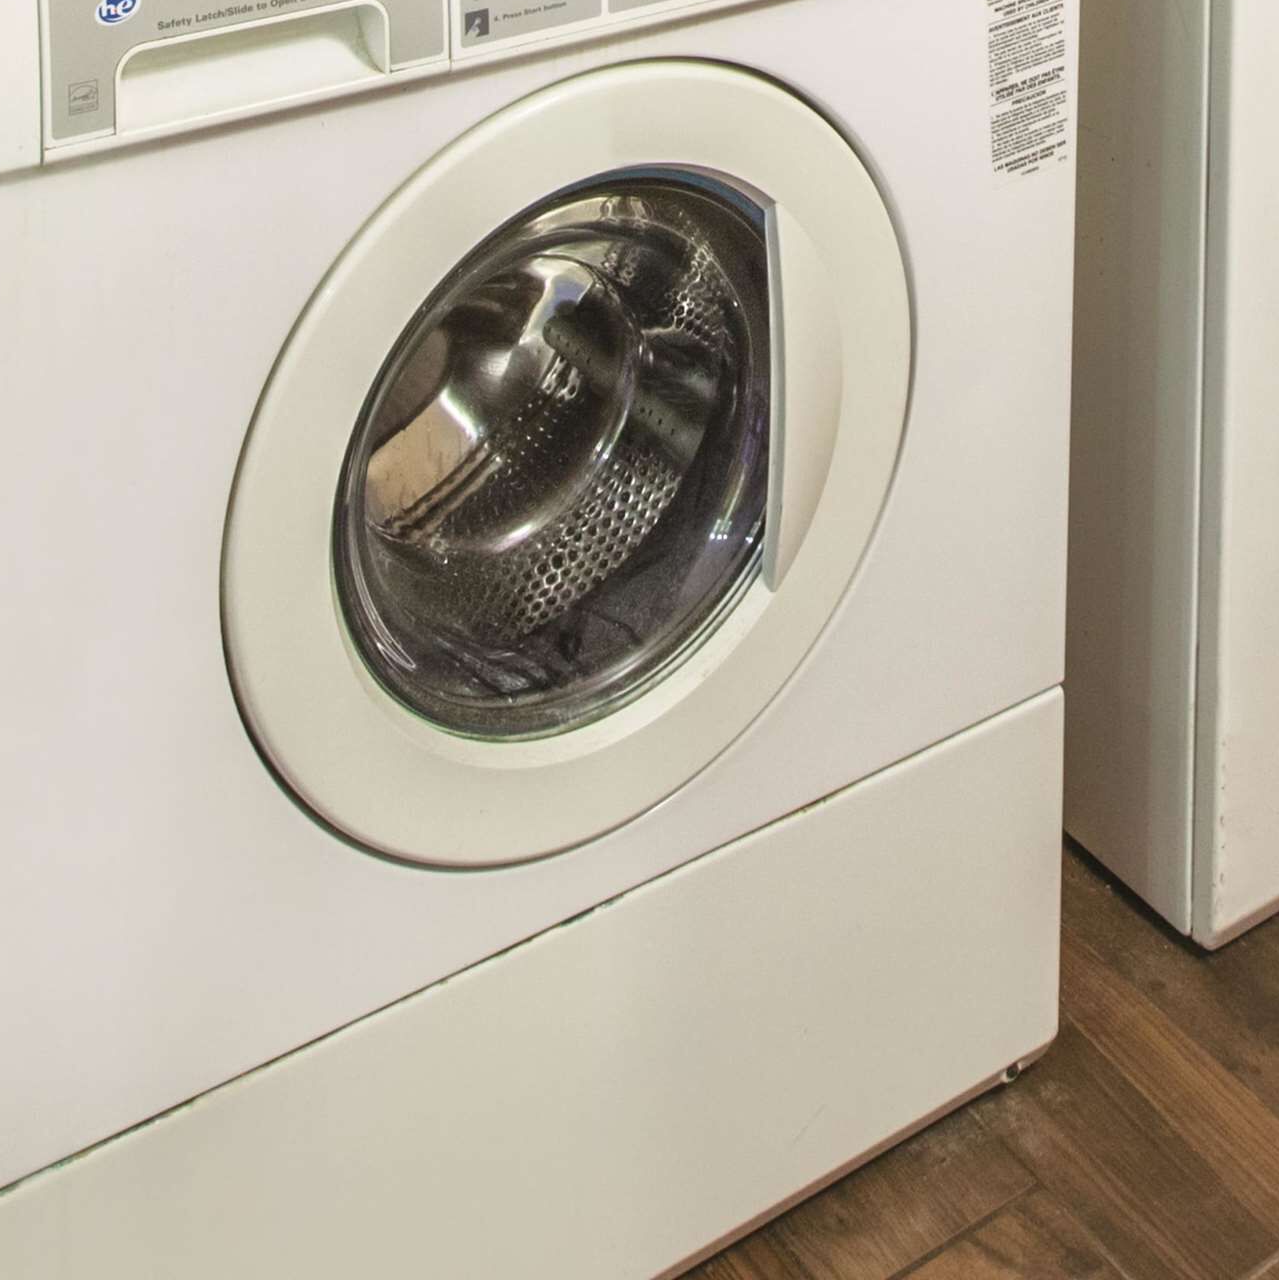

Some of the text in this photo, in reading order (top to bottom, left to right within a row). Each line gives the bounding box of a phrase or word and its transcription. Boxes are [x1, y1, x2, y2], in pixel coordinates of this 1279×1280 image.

[157, 19, 192, 31] Safety
[195, 3, 254, 24] Latch/Slide
[256, 1, 267, 11] to
